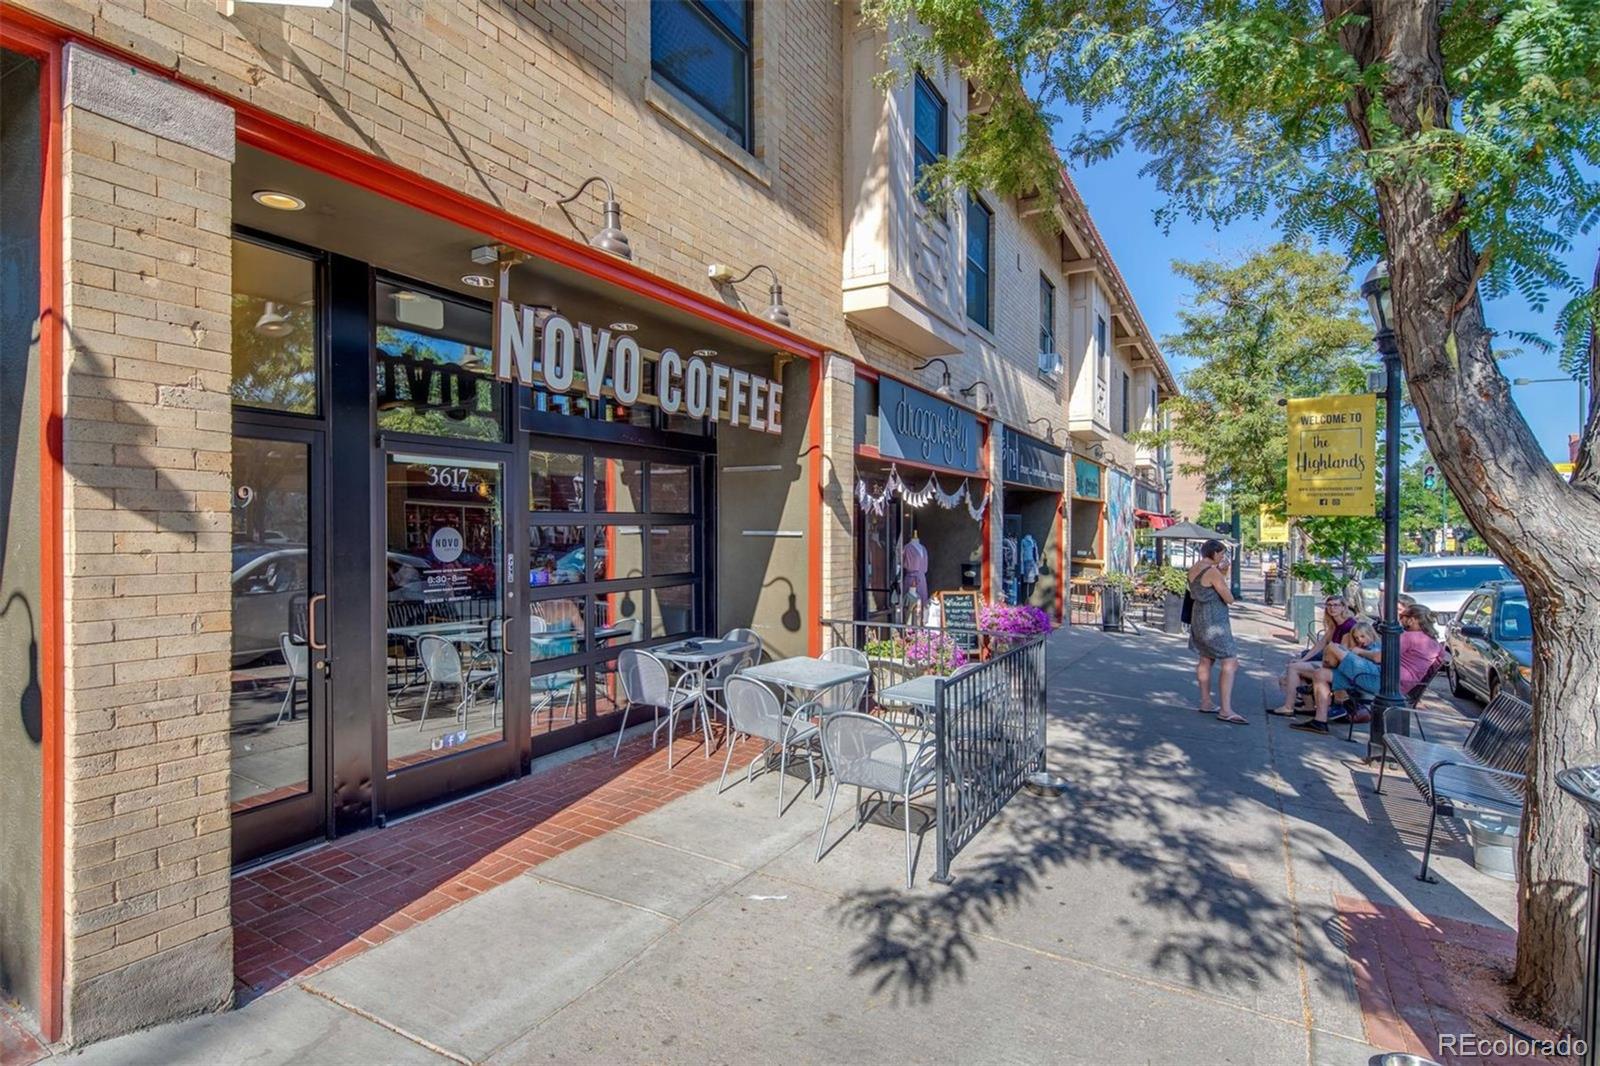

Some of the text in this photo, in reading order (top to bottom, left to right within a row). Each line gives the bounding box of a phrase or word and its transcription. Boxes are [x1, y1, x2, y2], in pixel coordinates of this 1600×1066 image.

[496, 297, 783, 435] NOVO COFFEE
[896, 387, 970, 468] dragonfly
[1300, 412, 1362, 425] WELCOME TO
[1313, 434, 1329, 449] the
[1296, 452, 1365, 474] Highlands
[427, 467, 469, 488] 3617
[435, 538, 459, 548] NOVO
